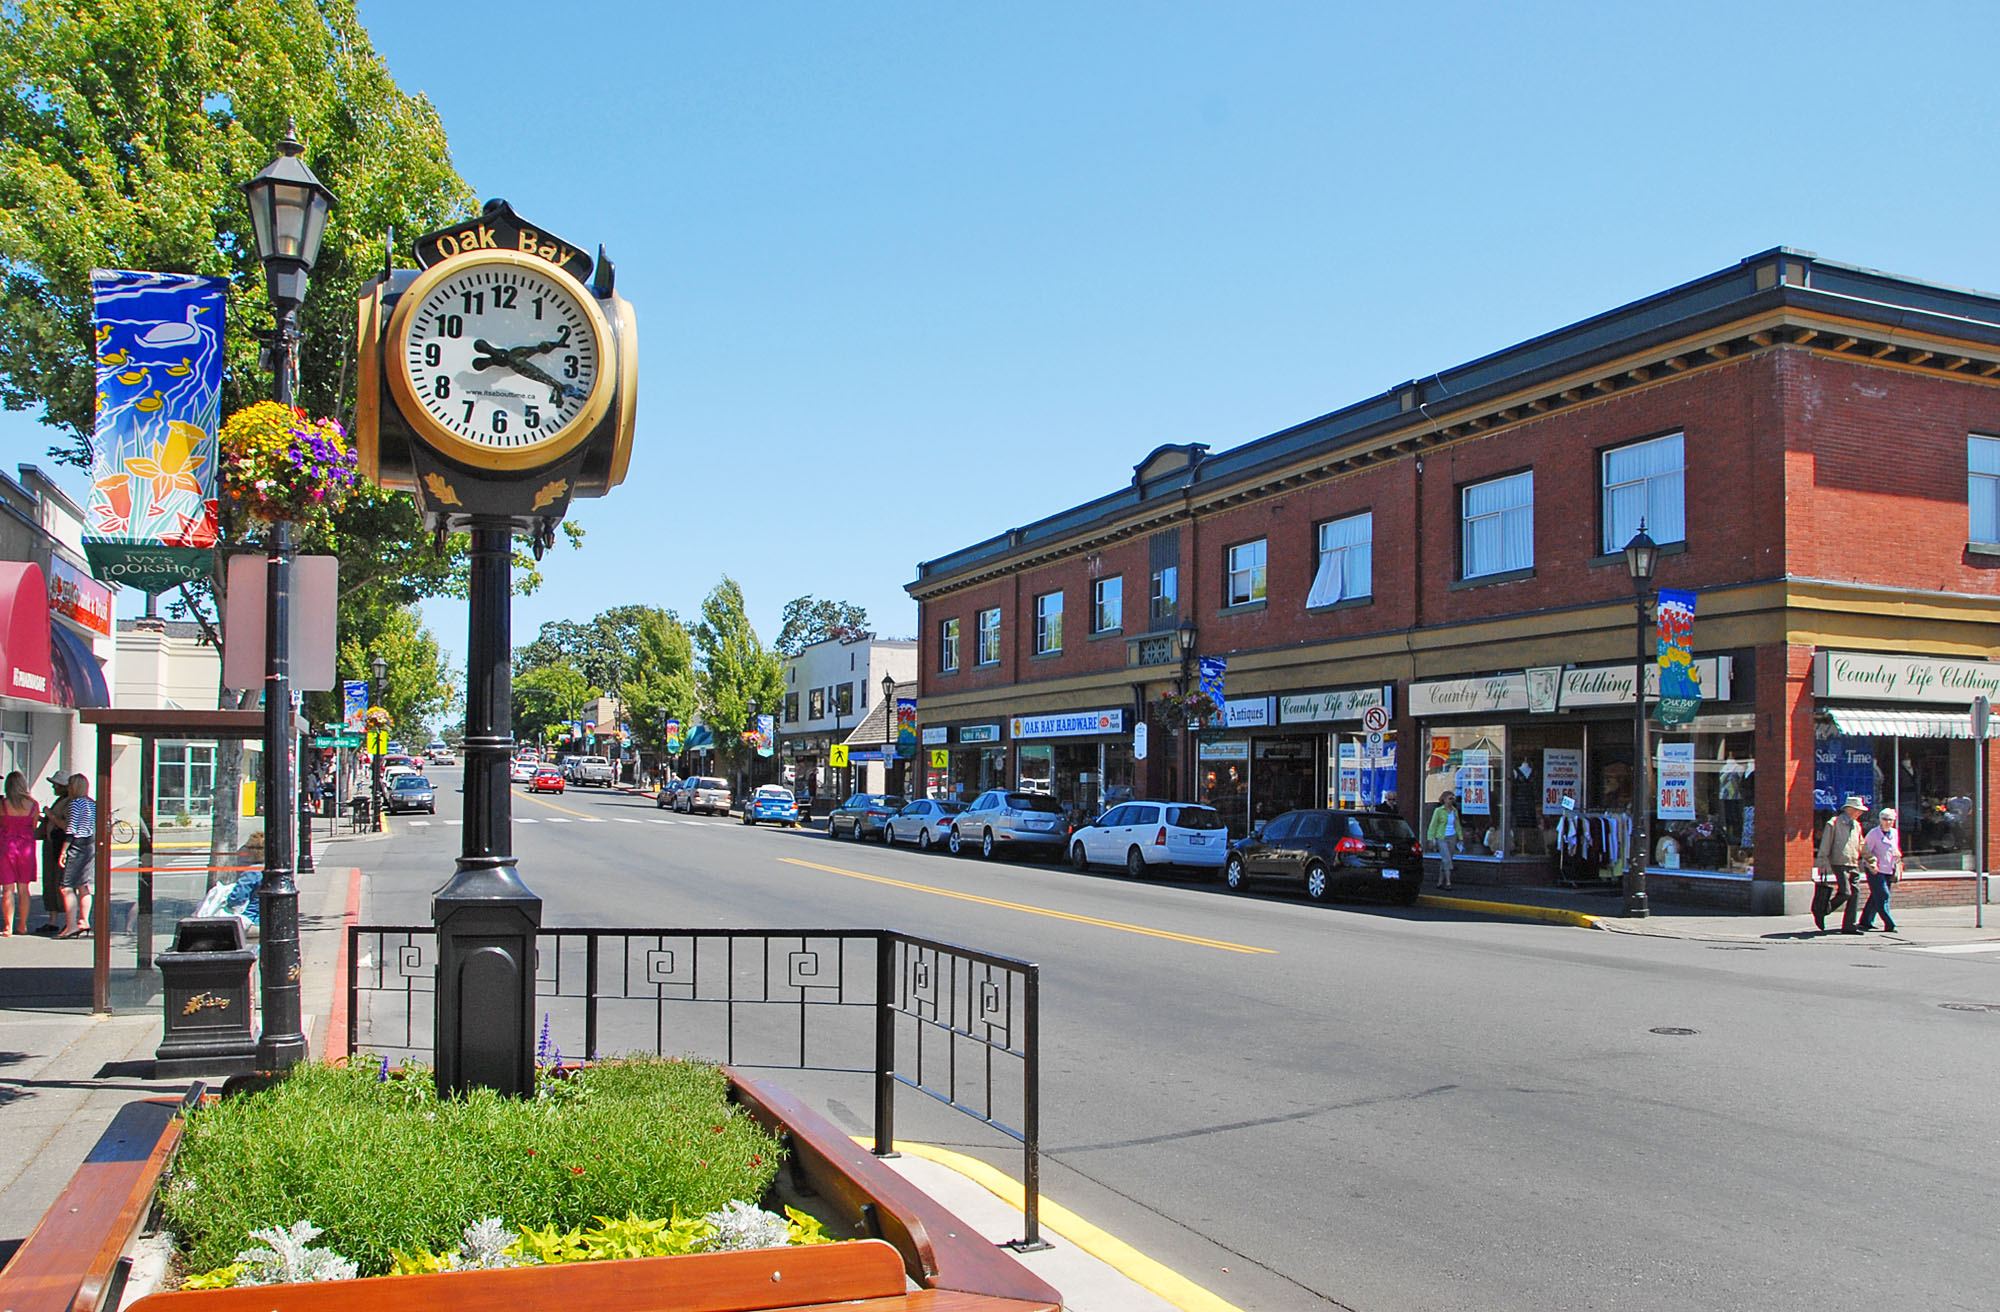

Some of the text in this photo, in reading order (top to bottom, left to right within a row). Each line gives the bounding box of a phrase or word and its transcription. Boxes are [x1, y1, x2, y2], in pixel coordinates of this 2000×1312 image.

[436, 223, 577, 267] Oak Bay
[461, 290, 484, 315] 11
[491, 285, 518, 310] 12
[531, 297, 543, 320] 1
[435, 314, 463, 339] 10
[557, 325, 571, 348] 2
[425, 343, 441, 367] 9
[564, 355, 579, 379] 3
[435, 375, 450, 399] 8
[465, 389, 536, 400] www.itsabouttime.ca
[549, 386, 564, 409] 4
[462, 400, 475, 424] 7
[492, 410, 508, 434] 6
[525, 405, 540, 429] 5
[125, 554, 174, 563] IVY'S
[101, 563, 201, 581] BOOKSHOP
[1834, 658, 2000, 698] Country Life Clothing
[1429, 684, 1479, 709] Country
[1485, 680, 1511, 708] Life
[1568, 672, 1633, 700] Clothing
[1230, 707, 1264, 722] Antiques
[1282, 697, 1319, 720] Country
[1324, 694, 1343, 718] Life
[1025, 719, 1039, 734] OAK
[1041, 718, 1055, 733] BAY
[1056, 716, 1097, 732] HARDWARE
[1815, 749, 1872, 764] Sale Time
[1815, 790, 1838, 805] Sale
